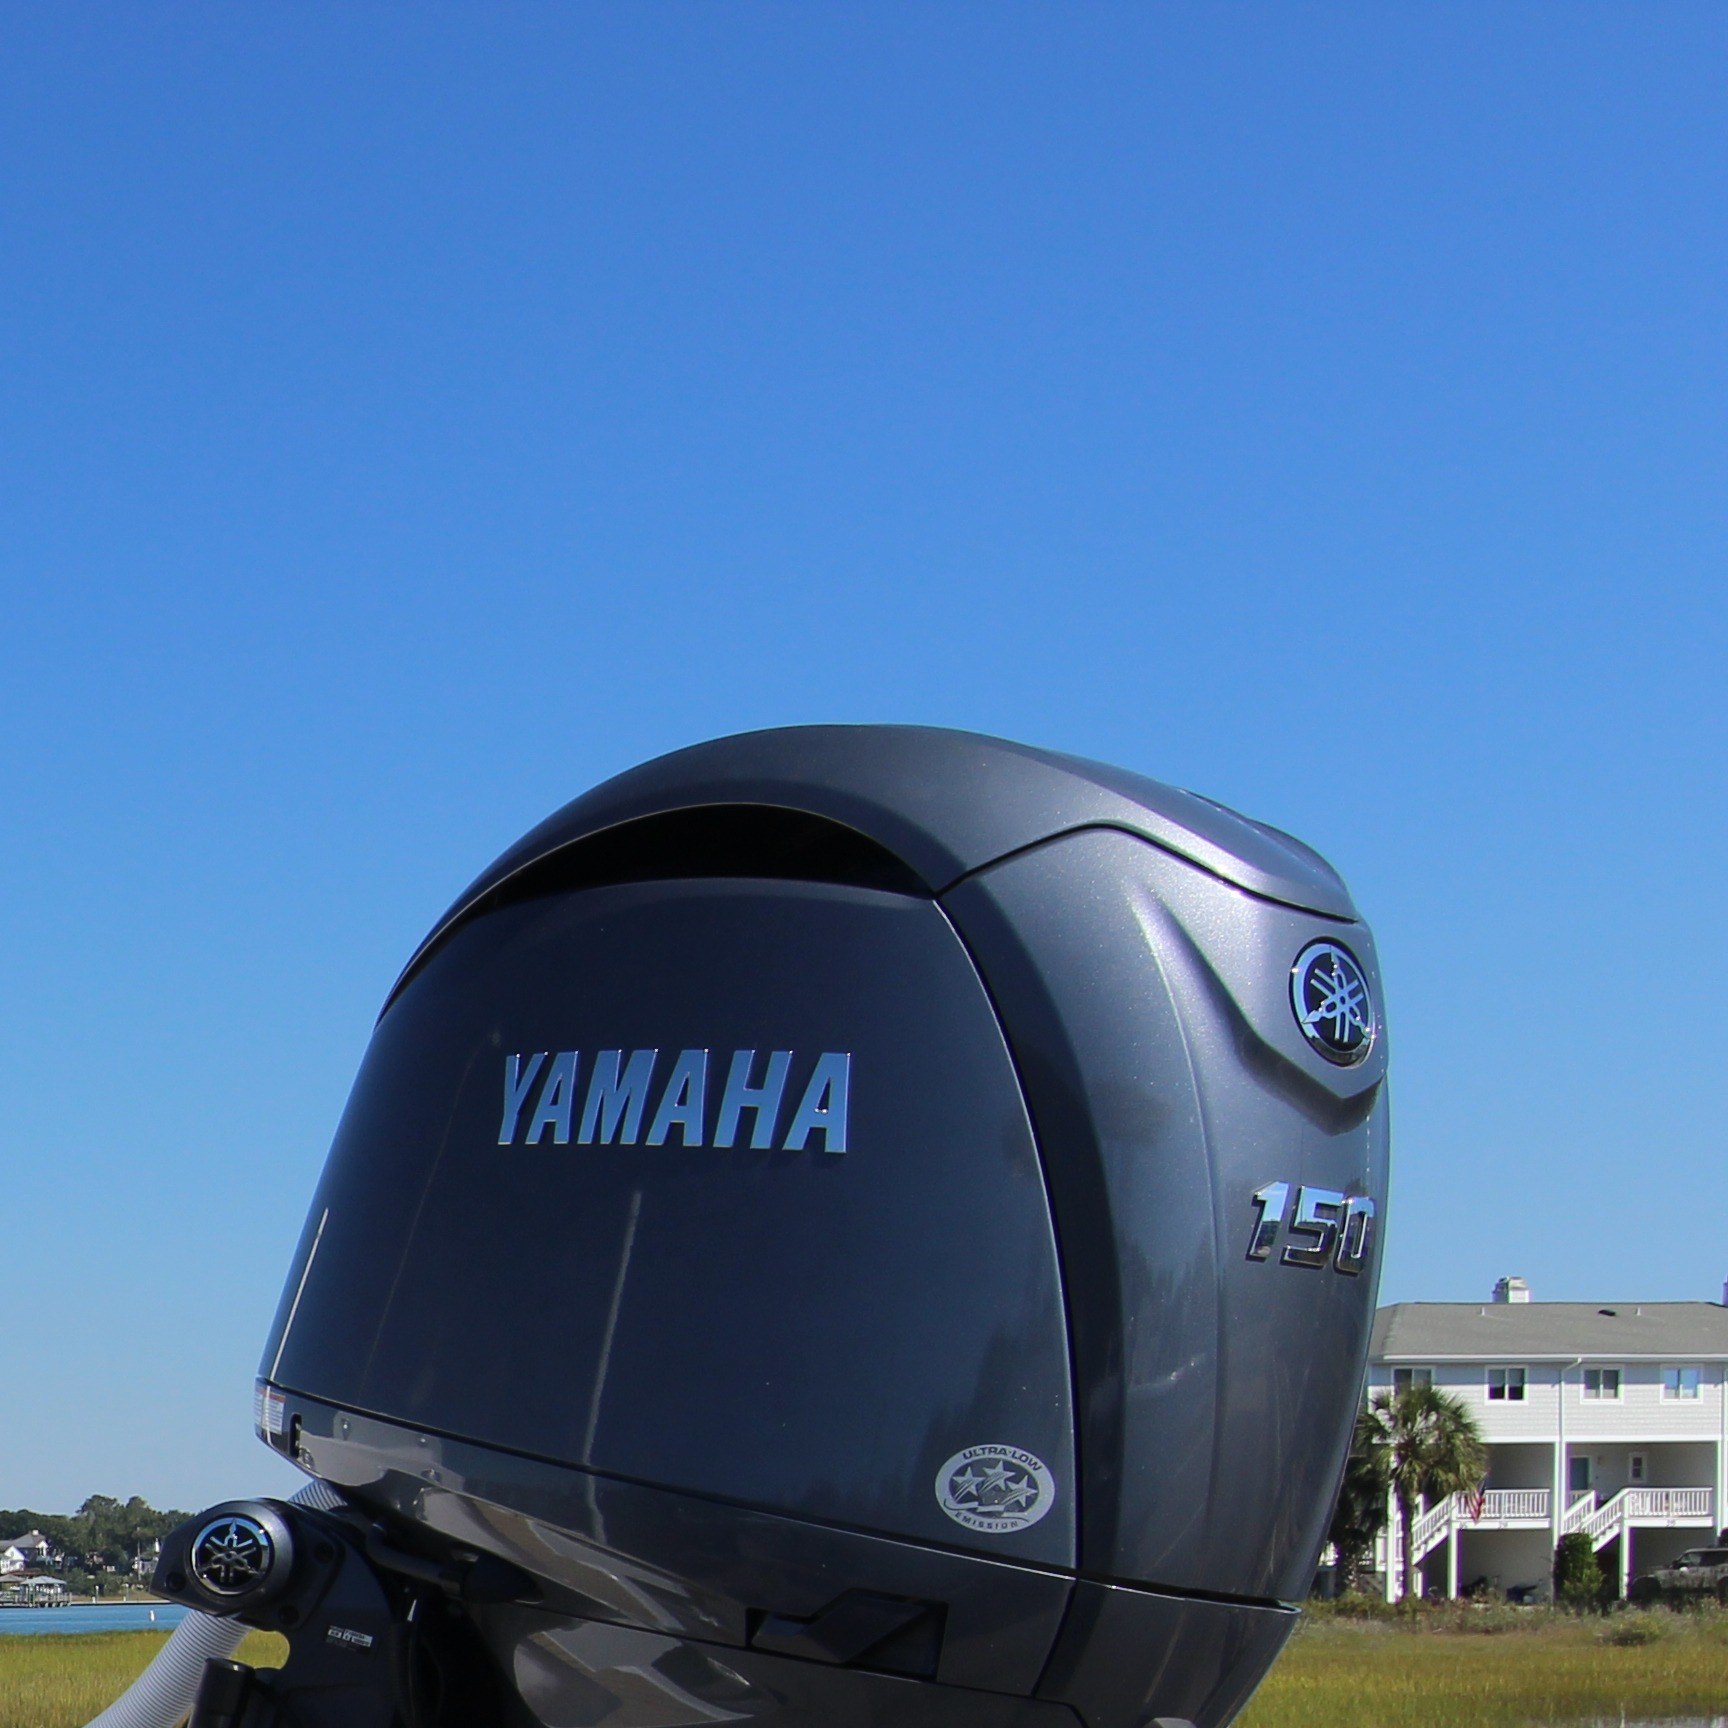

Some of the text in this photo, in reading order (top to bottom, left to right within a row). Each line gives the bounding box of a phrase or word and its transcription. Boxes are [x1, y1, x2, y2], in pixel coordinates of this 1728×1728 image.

[497, 1049, 851, 1153] YAMAHA
[1246, 1178, 1375, 1277] 150
[954, 1511, 1019, 1530] EMISSION
